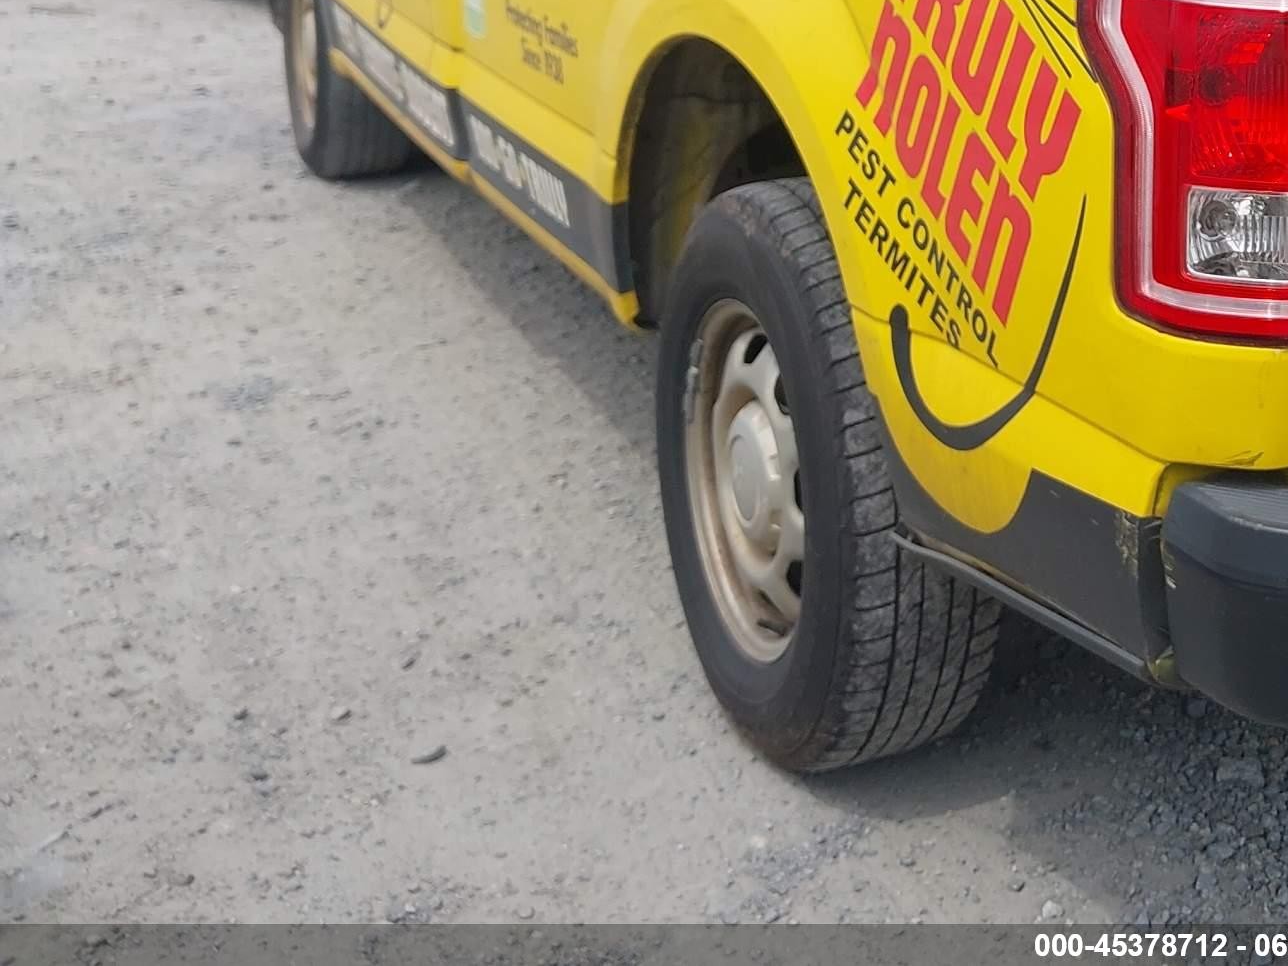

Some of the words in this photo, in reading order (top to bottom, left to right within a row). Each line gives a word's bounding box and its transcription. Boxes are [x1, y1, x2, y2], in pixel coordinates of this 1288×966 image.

[835, 109, 896, 199] PEST
[897, 197, 999, 368] CONTROL
[843, 179, 962, 350] TERMITES
